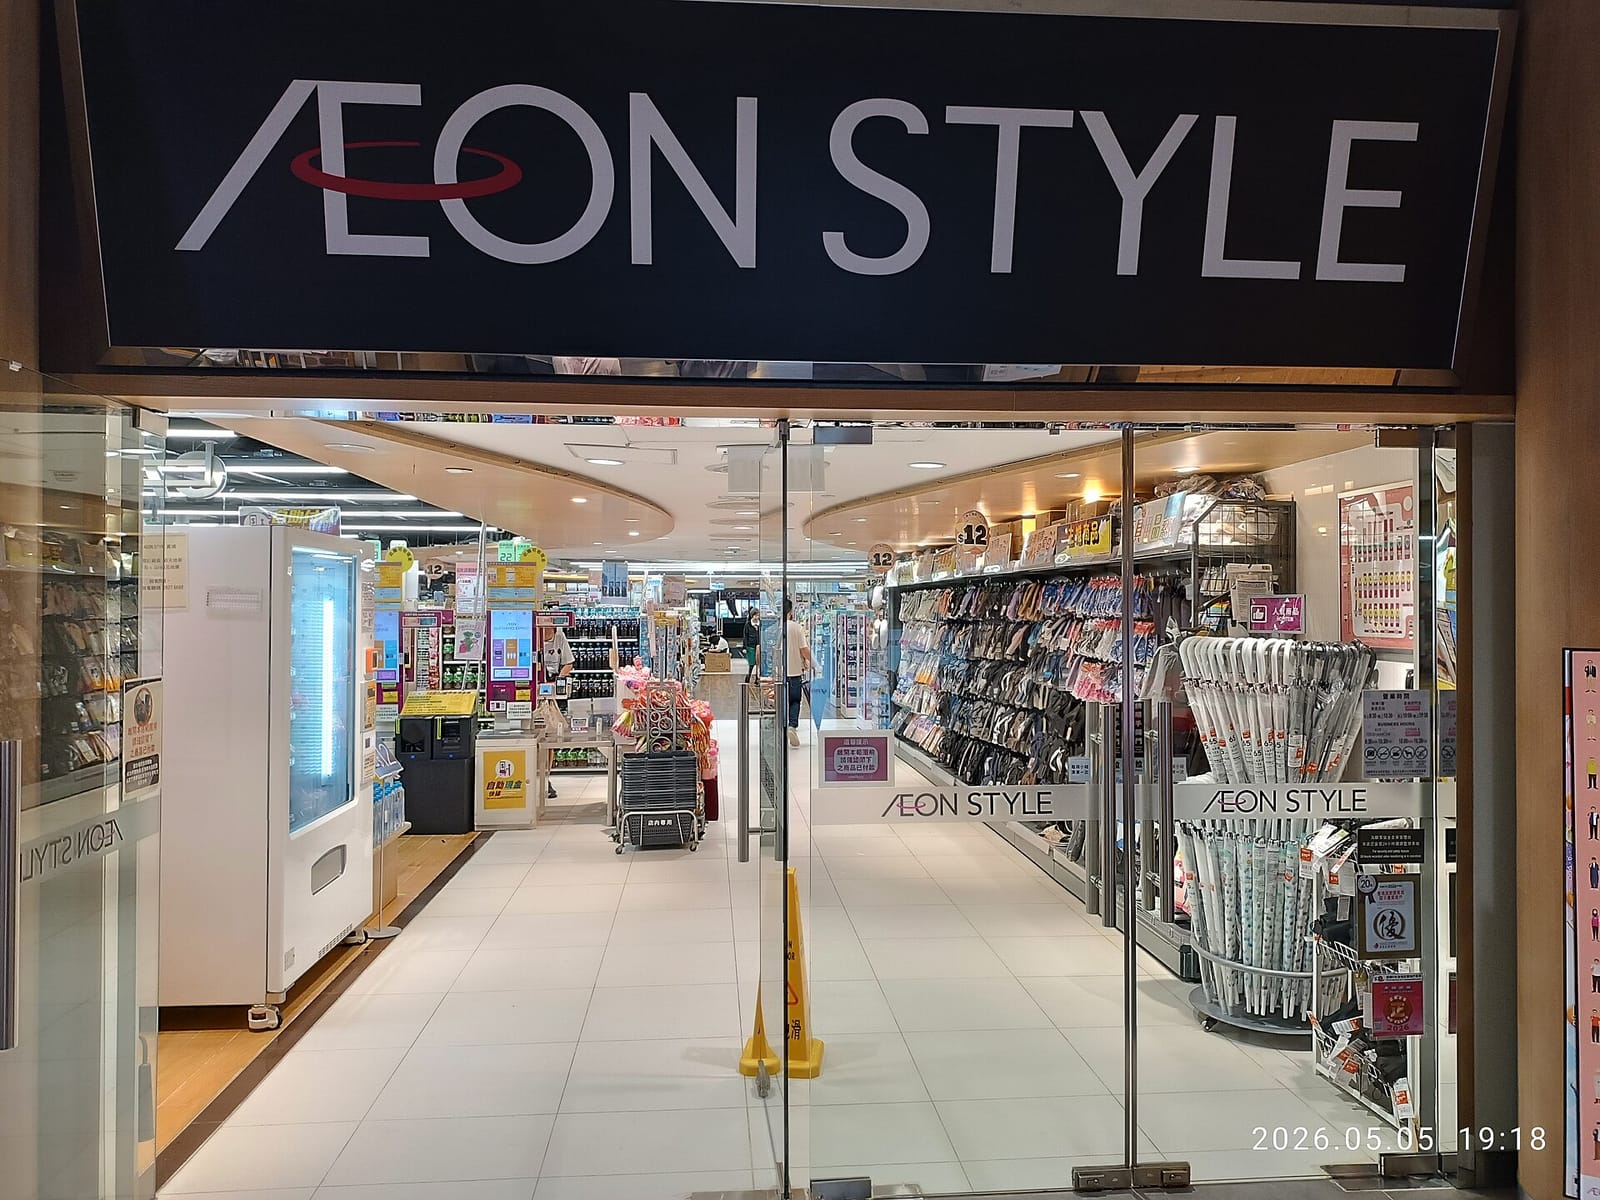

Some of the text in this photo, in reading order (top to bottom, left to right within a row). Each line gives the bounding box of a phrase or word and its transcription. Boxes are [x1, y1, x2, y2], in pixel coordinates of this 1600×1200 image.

[822, 97, 1420, 283] STYLE
[957, 524, 988, 546] $12
[967, 789, 1053, 816] STYLE
[1285, 789, 1367, 813] STYLE
[1387, 1024, 1410, 1032] 2026
